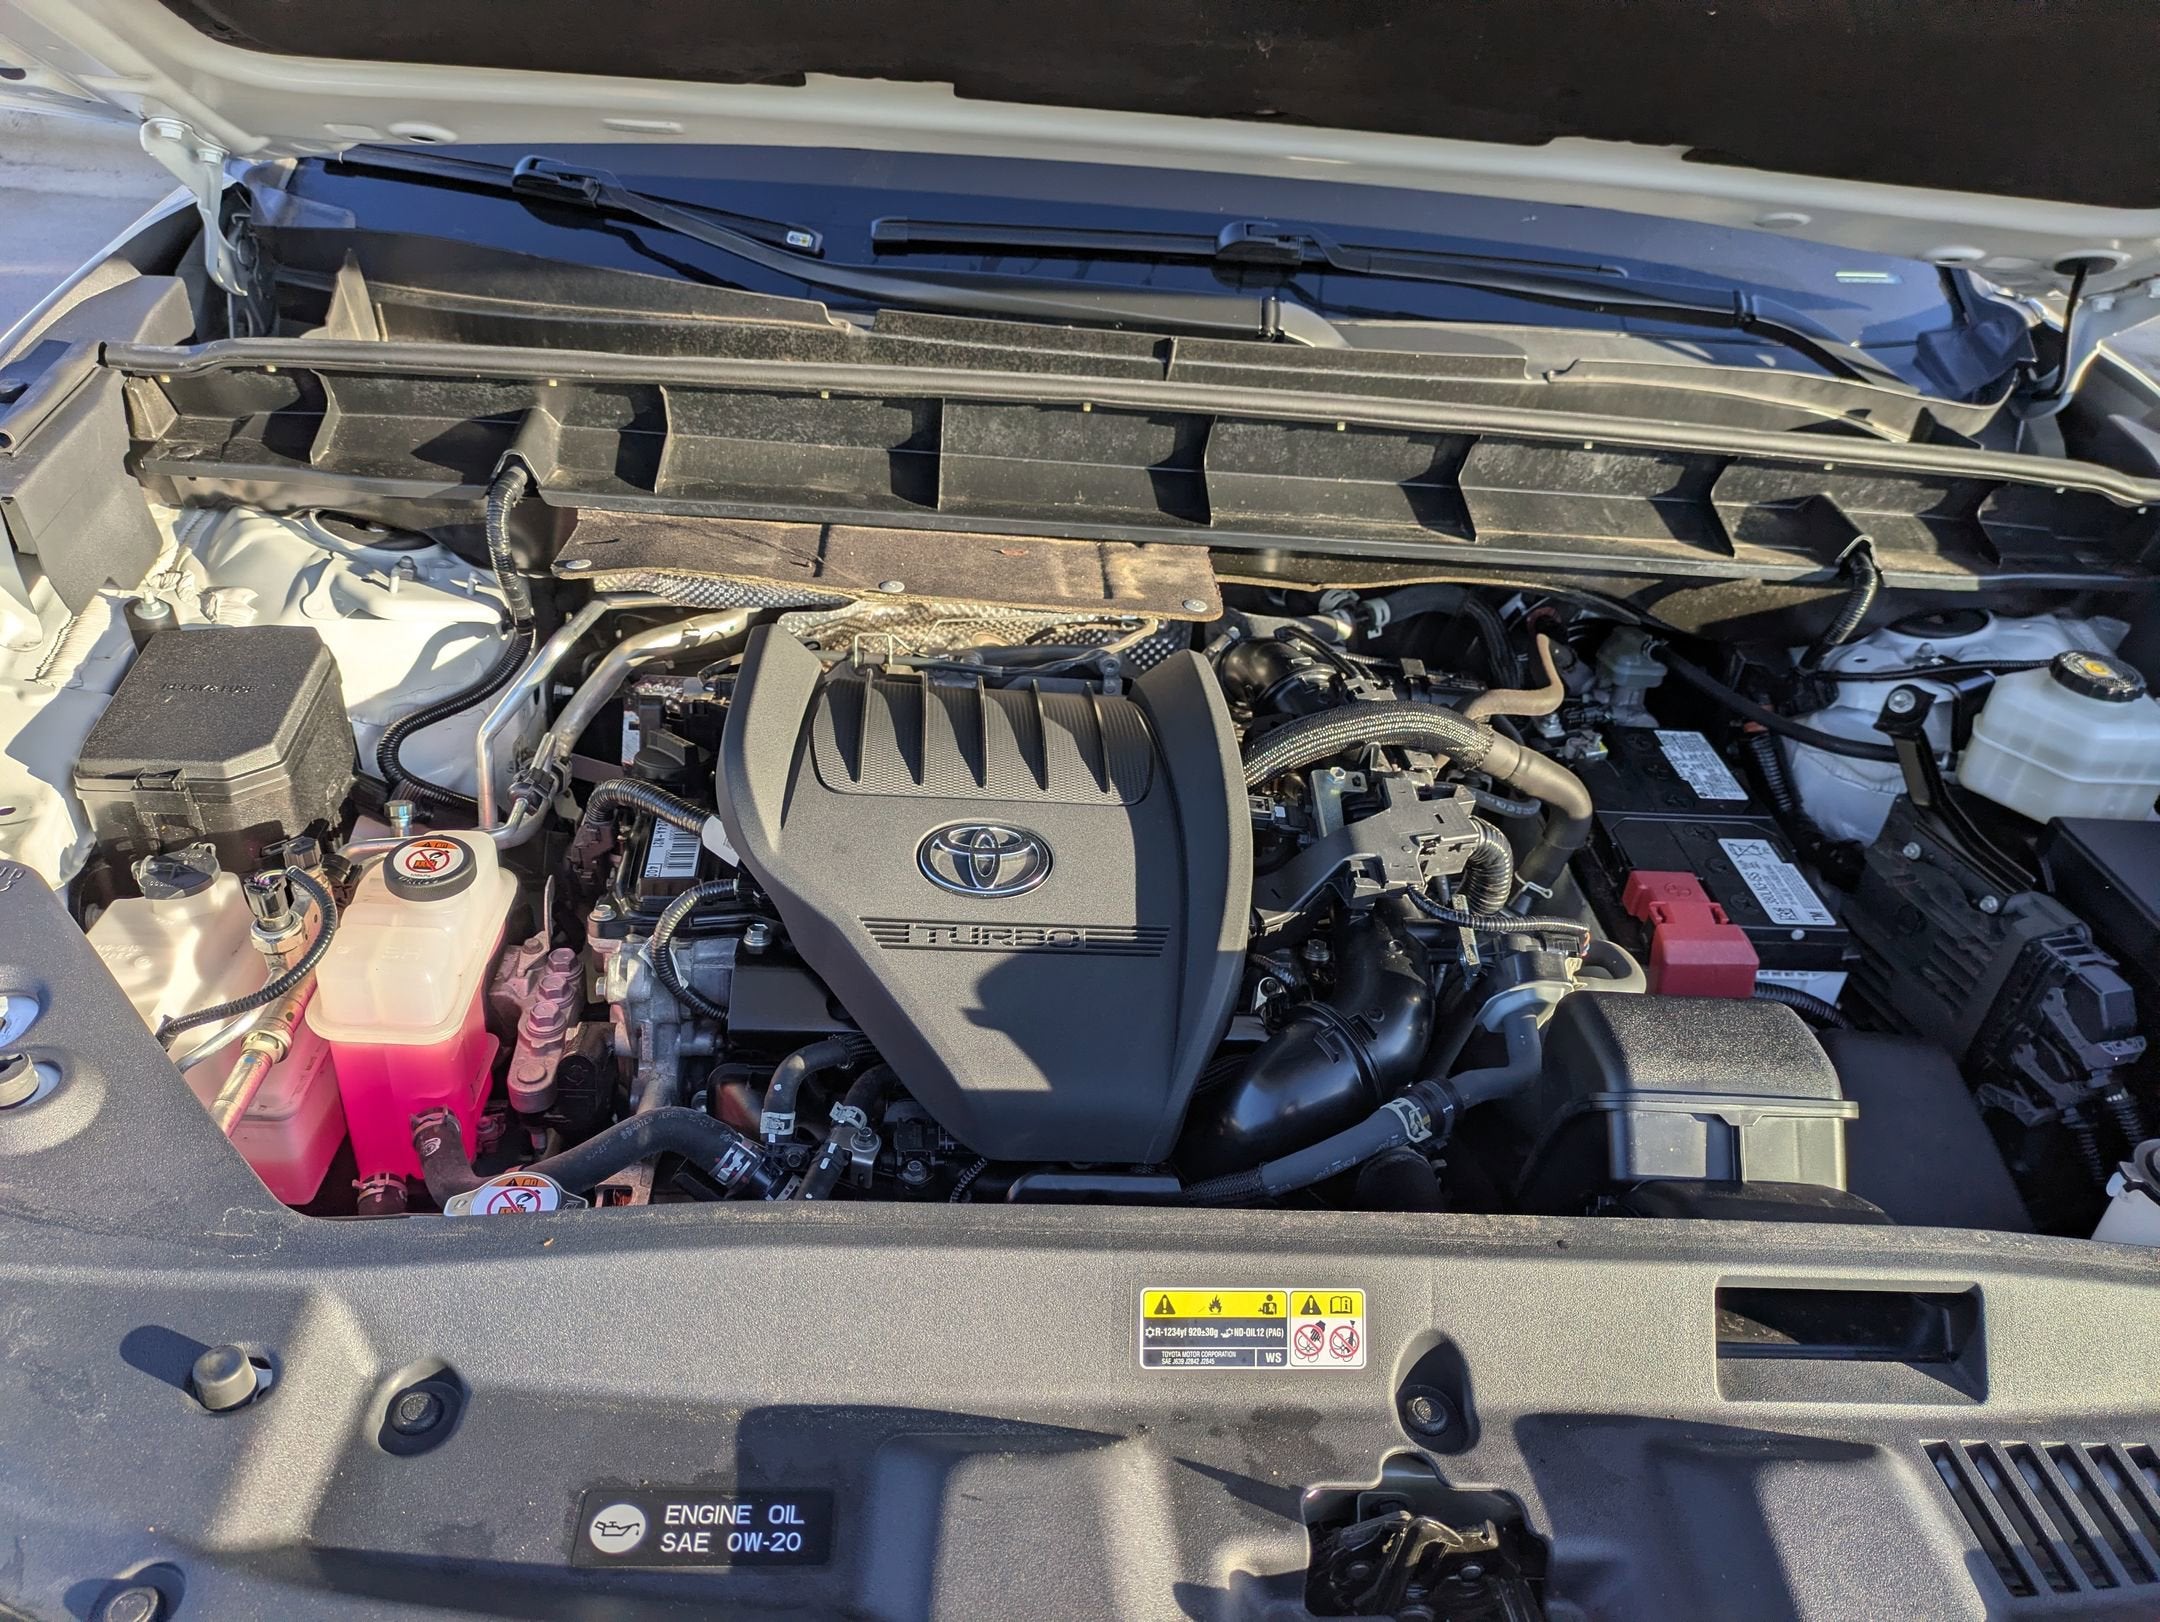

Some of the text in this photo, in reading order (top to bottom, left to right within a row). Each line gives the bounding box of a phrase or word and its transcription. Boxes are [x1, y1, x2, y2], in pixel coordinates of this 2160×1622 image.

[913, 923, 1081, 949] TURBO
[1155, 1327, 1285, 1340] R-1234yf 920±30g ND-OIL12 (PAG)
[1161, 1350, 1237, 1358] TOYOTA MOTOR CORPORATION
[1265, 1352, 1282, 1364] WS
[664, 1504, 805, 1525] ENGINE OIL
[660, 1531, 802, 1553] SAE 0W-20
